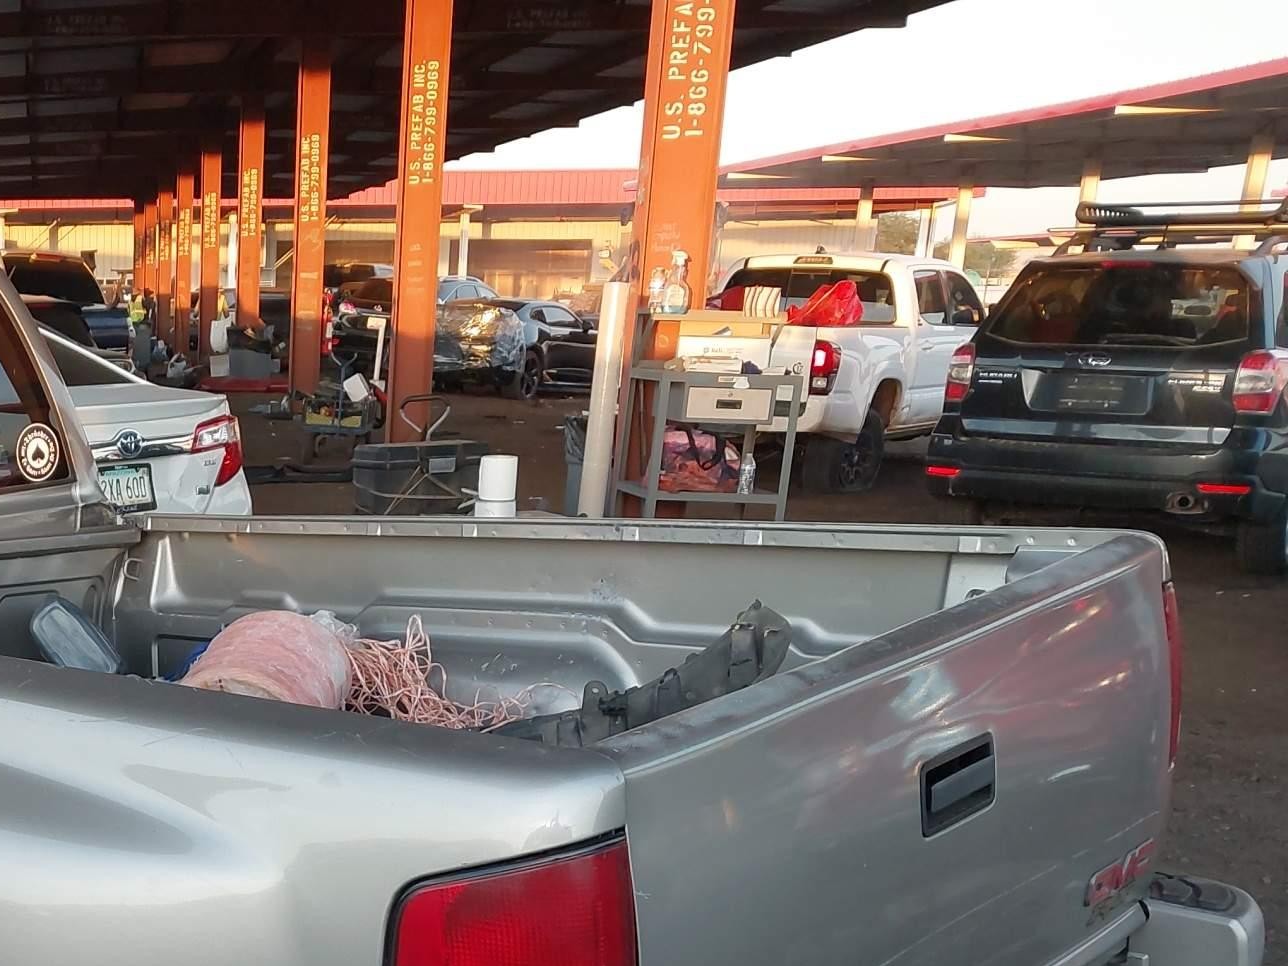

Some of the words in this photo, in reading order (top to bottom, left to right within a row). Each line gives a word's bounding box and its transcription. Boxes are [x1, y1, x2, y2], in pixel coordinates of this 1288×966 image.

[413, 59, 427, 88] INC.
[410, 94, 425, 150] PREFAB
[421, 60, 440, 184] 1-866-799-0969
[661, 94, 684, 140] U.S.
[301, 158, 310, 198] PREFAB
[310, 134, 320, 220] 1-866-799-0969
[408, 157, 422, 185] U.S.
[300, 202, 310, 222] U.S.
